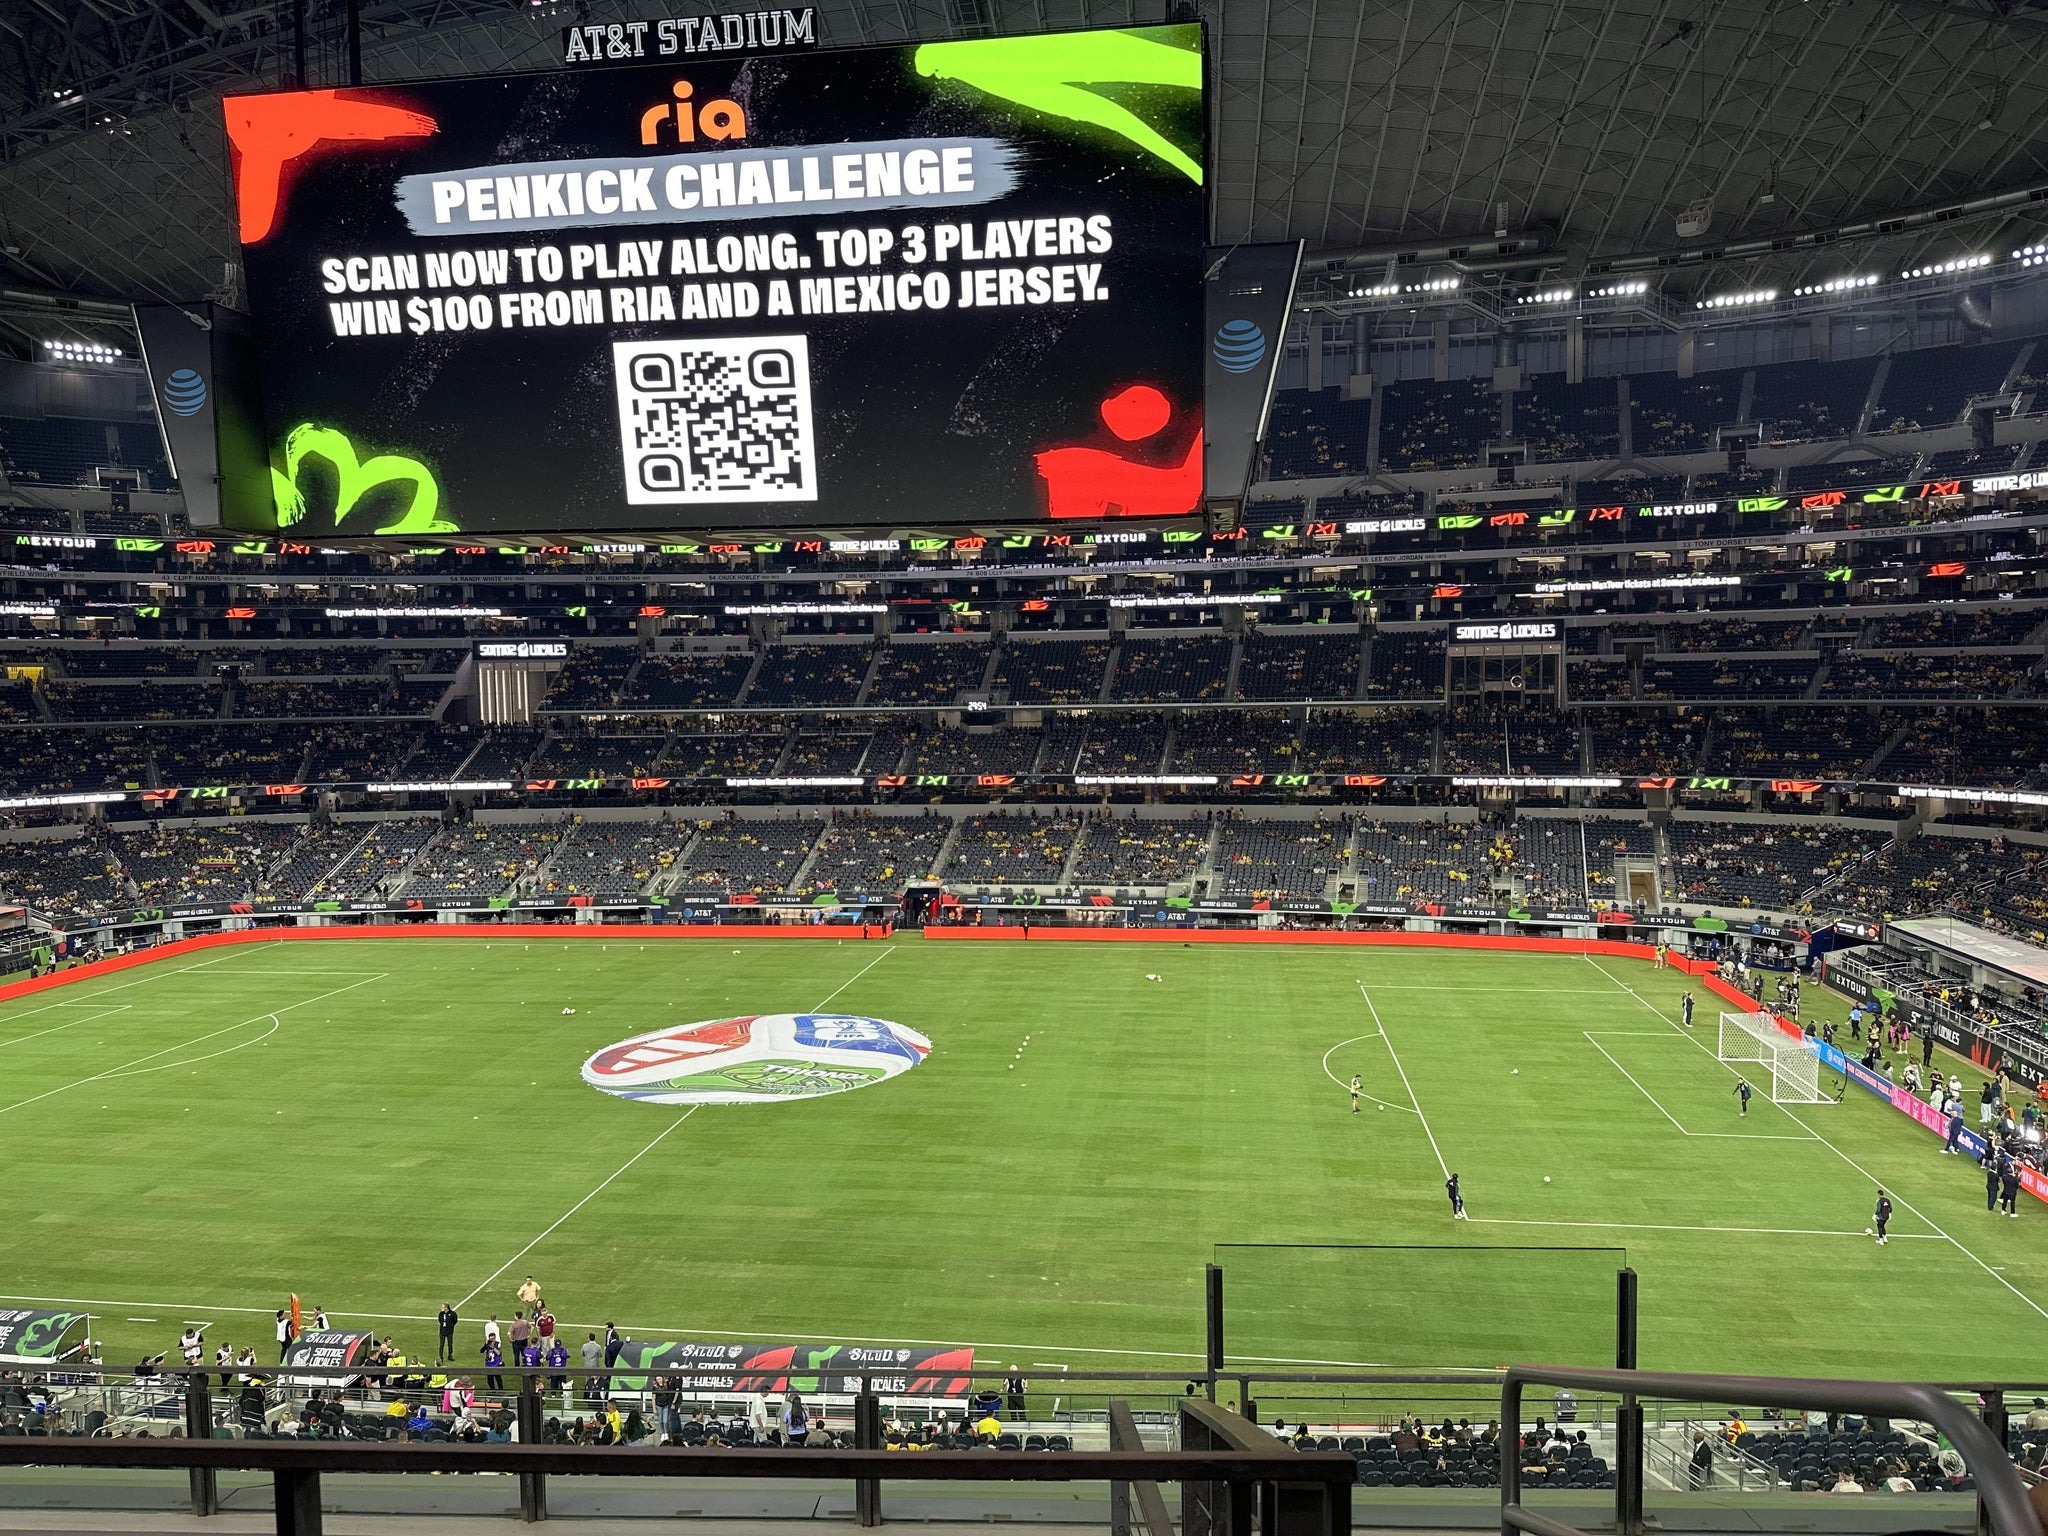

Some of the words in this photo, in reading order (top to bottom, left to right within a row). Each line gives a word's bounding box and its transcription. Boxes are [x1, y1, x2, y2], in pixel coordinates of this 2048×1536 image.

[566, 21, 648, 62] AT&T
[657, 8, 815, 55] STADIUM
[640, 80, 747, 145] ria
[432, 167, 658, 224] PENKICK
[664, 147, 975, 210] CHALLENGE
[321, 254, 420, 295] SCAN
[425, 249, 509, 291] NOW
[514, 246, 563, 284] TO
[569, 240, 664, 281] PLAY
[671, 231, 811, 276] ALONG.
[816, 228, 894, 268] TOP
[901, 225, 927, 264] 3
[934, 214, 1113, 262] PLAYERS
[329, 299, 402, 337] WIN
[408, 294, 494, 337] $100
[499, 288, 605, 328] FROM
[610, 284, 677, 323] RIA
[681, 281, 760, 319] AND
[767, 279, 795, 316] A
[800, 271, 951, 315] MEXICO
[958, 263, 1109, 309] JERSEY.
[1639, 503, 1718, 517] MEXTOUR
[1084, 532, 1147, 544] MEXTOUR
[1870, 529, 1886, 537] TEX
[1889, 526, 1932, 536] SCHRAMM
[16, 536, 96, 548] MEXTOUR
[582, 544, 645, 553] MEXTOUR
[1695, 540, 1715, 548] TONY
[1716, 538, 1752, 547] DORSETT
[1549, 547, 1577, 555] LANDRY
[1549, 583, 1566, 593] your
[1624, 579, 1651, 589] tickets
[1513, 624, 1556, 638] LOCALES
[529, 644, 567, 657] LOCALES
[867, 896, 883, 904] AT&T
[990, 896, 1006, 904] AT&T
[694, 909, 713, 918] AT&T
[1167, 912, 1187, 921] AT&T
[100, 917, 118, 925] AT&T
[1762, 927, 1780, 937] AT&T
[1829, 970, 1867, 997] MEXTOUR
[763, 1064, 869, 1080] TRIONDA
[2012, 1061, 2045, 1084] MEXT
[871, 1377, 906, 1392] OCALES
